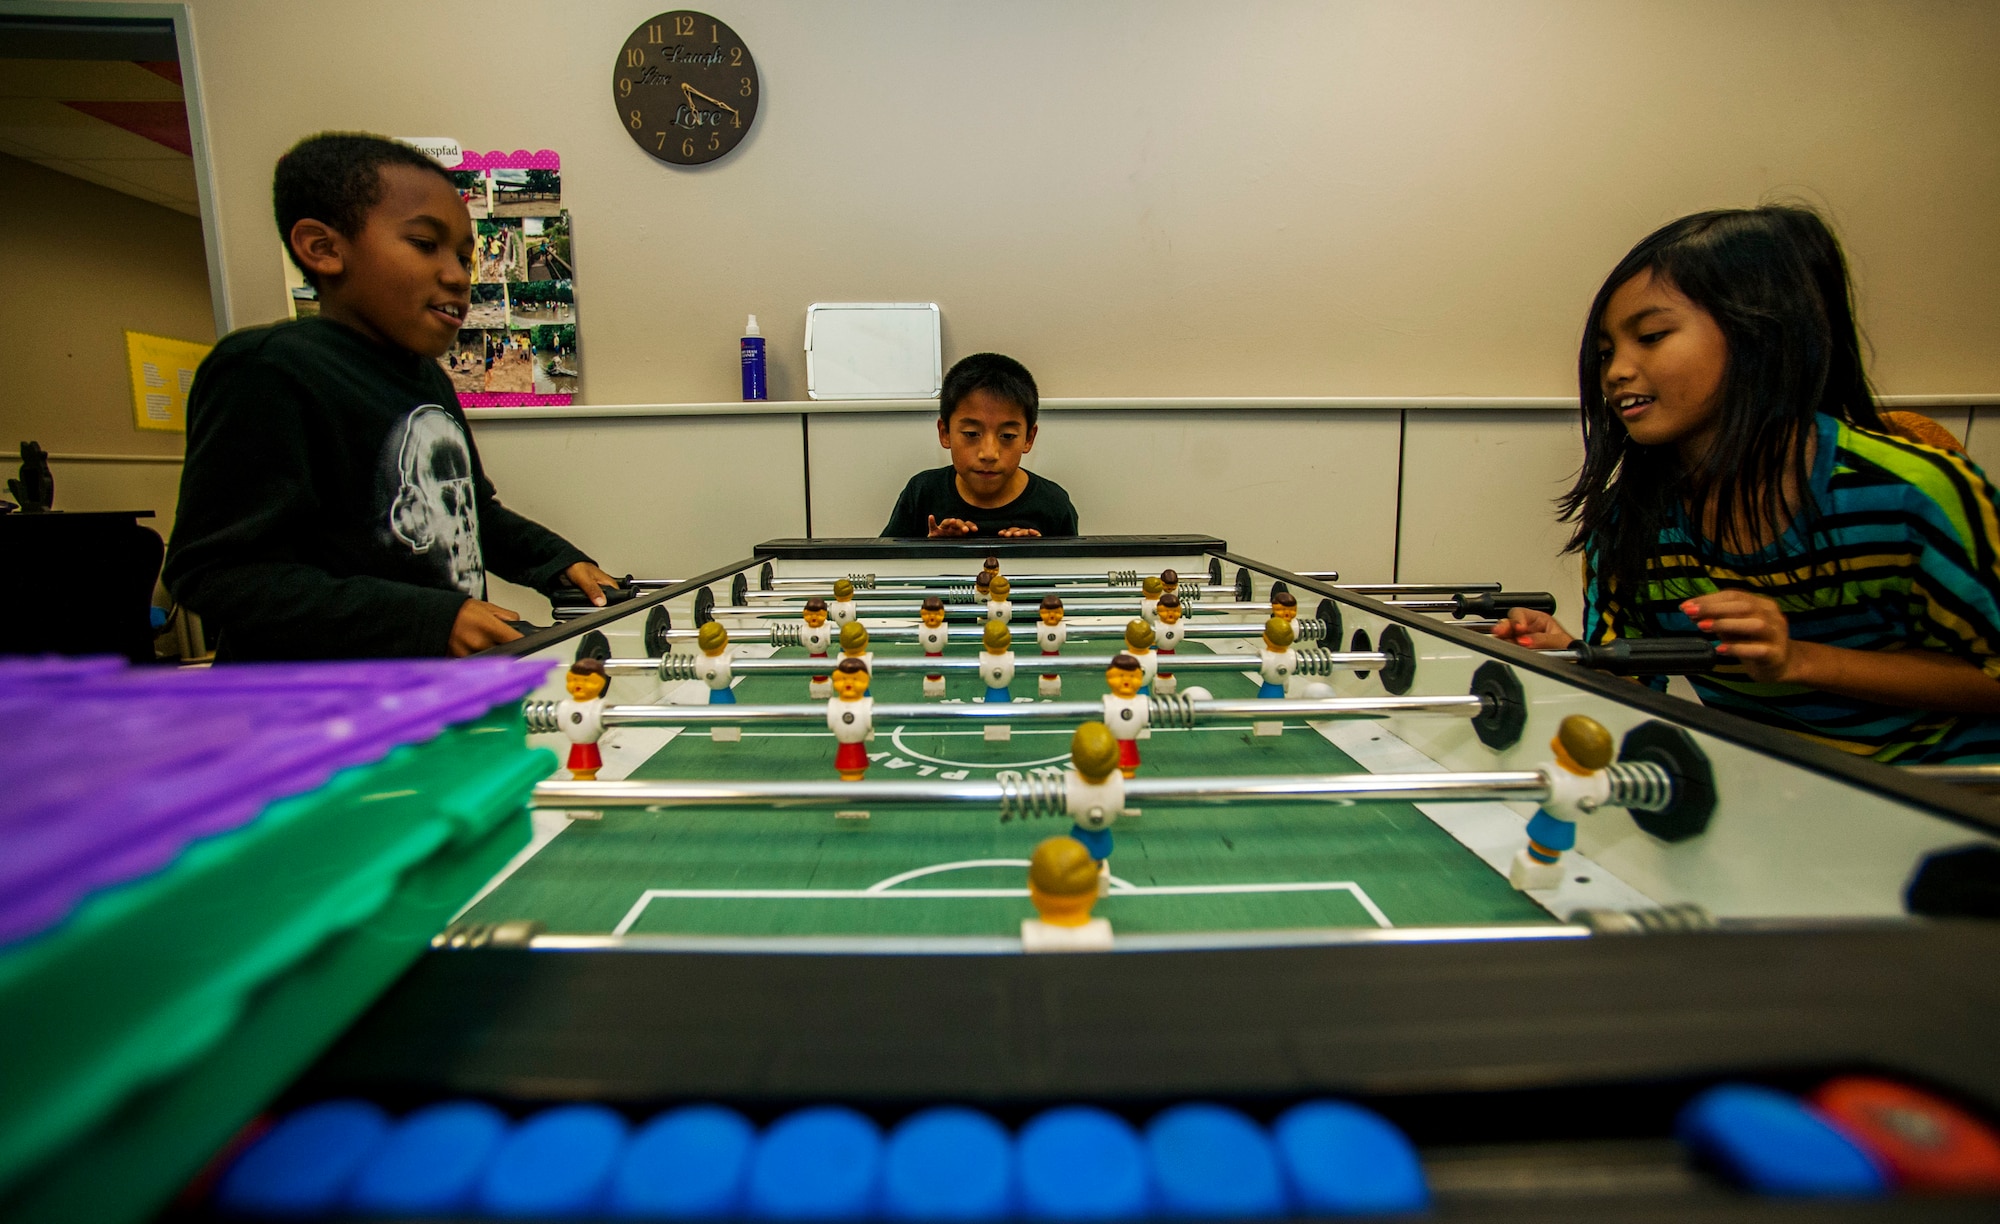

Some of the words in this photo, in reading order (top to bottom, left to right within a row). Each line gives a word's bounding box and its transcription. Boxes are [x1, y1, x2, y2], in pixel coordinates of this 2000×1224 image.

[648, 24, 664, 44] 11
[674, 15, 695, 36] 12
[711, 24, 719, 44] 1
[627, 48, 645, 68] 10
[661, 44, 726, 70] Laugh
[730, 47, 742, 67] 2
[634, 65, 672, 86] Live
[619, 78, 632, 98] 9
[739, 77, 752, 97] 3
[630, 110, 642, 130] 8
[670, 103, 722, 130] Love
[729, 110, 741, 129] 4
[656, 132, 666, 151] 7
[682, 138, 694, 158] 6
[708, 132, 720, 151] 5
